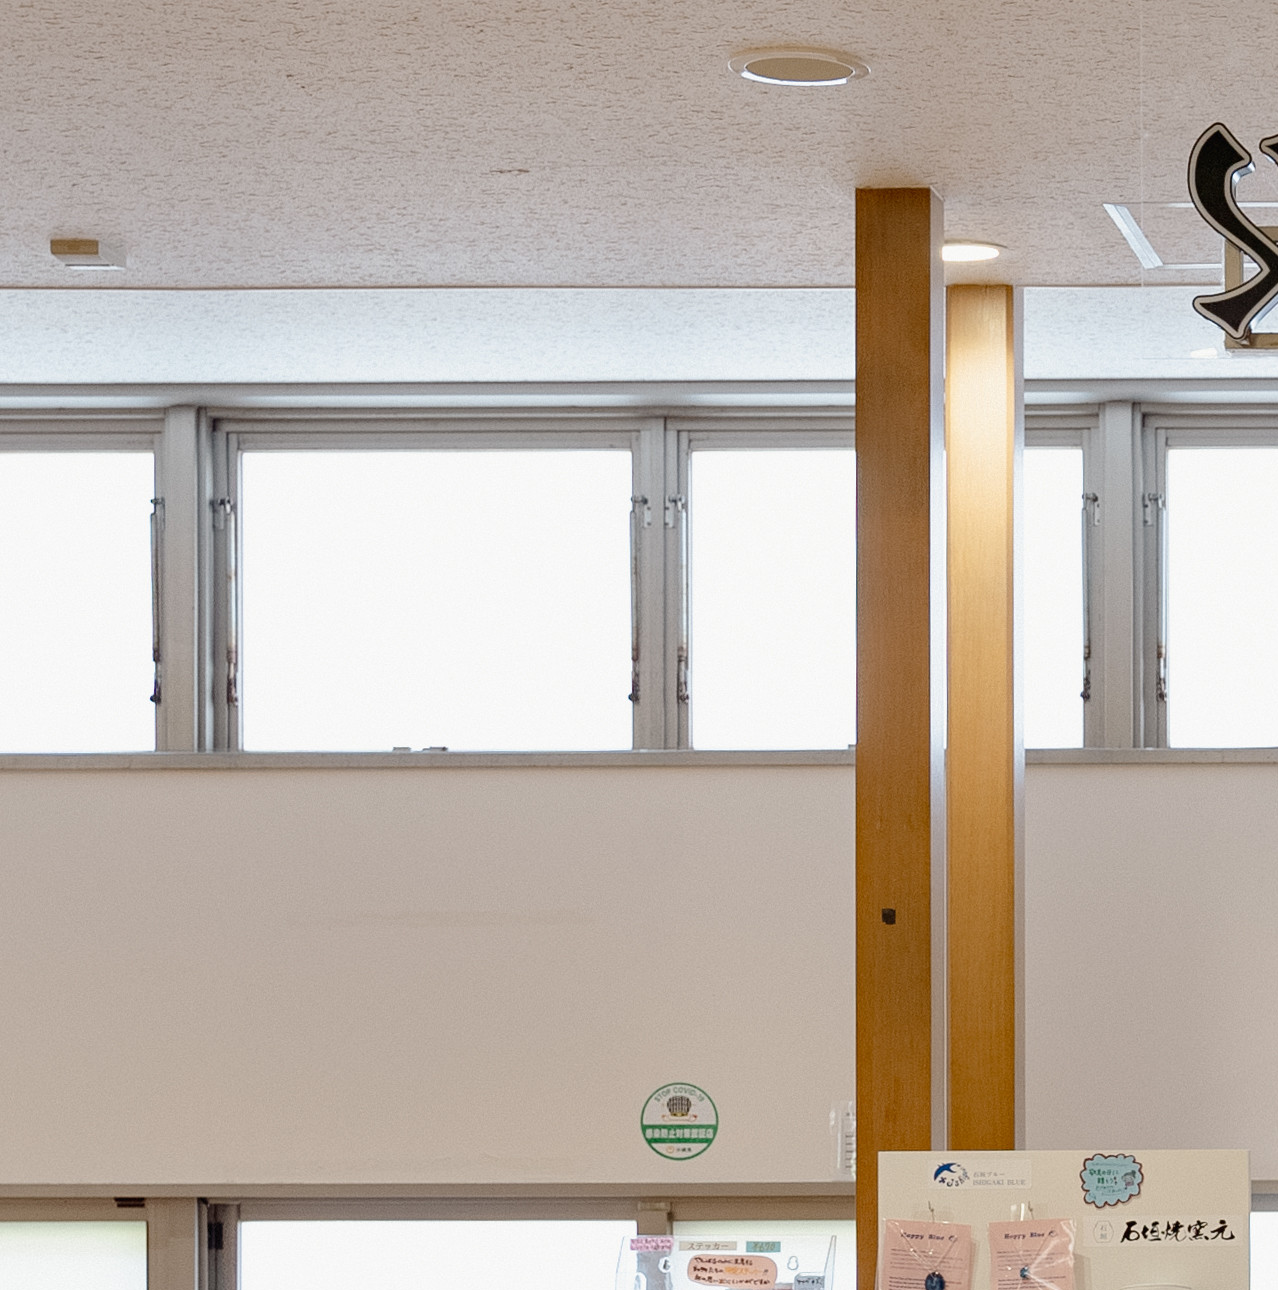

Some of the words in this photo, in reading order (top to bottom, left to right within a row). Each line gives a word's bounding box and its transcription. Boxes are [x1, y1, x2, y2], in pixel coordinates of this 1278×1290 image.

[687, 1242, 730, 1251] ステッカー
